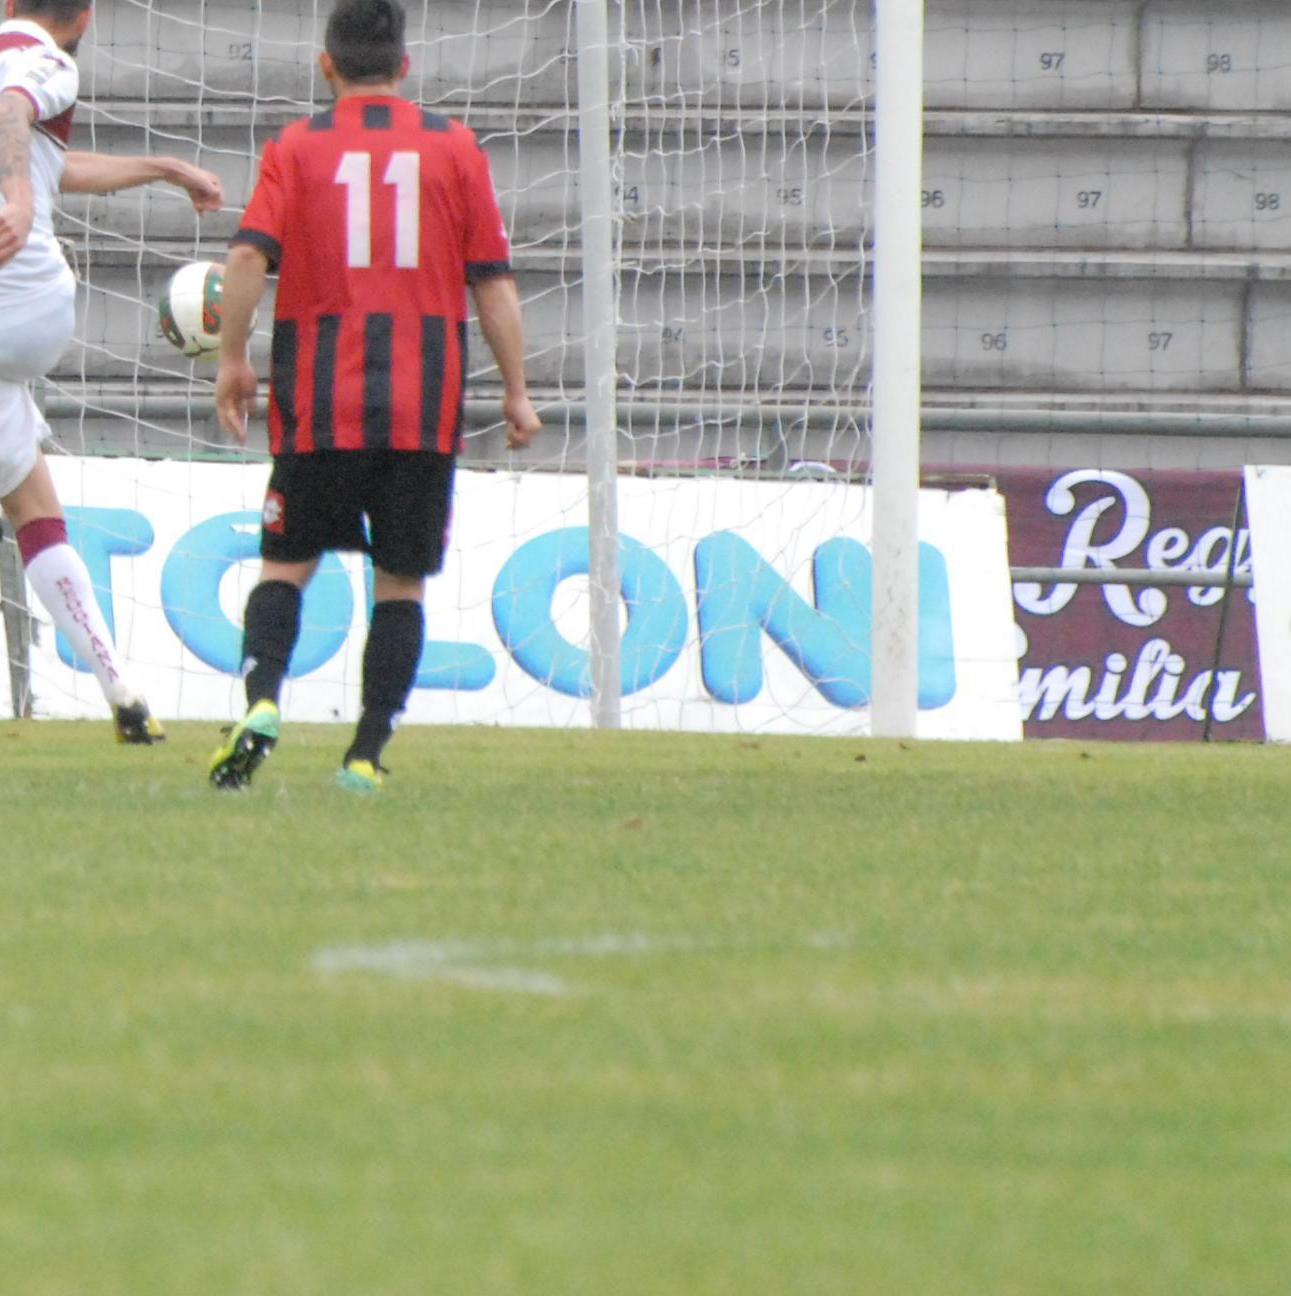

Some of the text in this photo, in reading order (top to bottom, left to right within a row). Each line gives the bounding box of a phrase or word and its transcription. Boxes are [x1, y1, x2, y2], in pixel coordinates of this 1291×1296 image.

[1039, 52, 1066, 71] 97
[1205, 53, 1233, 76] 98
[1077, 190, 1103, 209] 97
[1253, 192, 1281, 212] 98
[333, 151, 420, 269] 11
[981, 331, 1008, 352] 96
[1148, 332, 1174, 352] 97
[1014, 623, 1257, 722] milia
